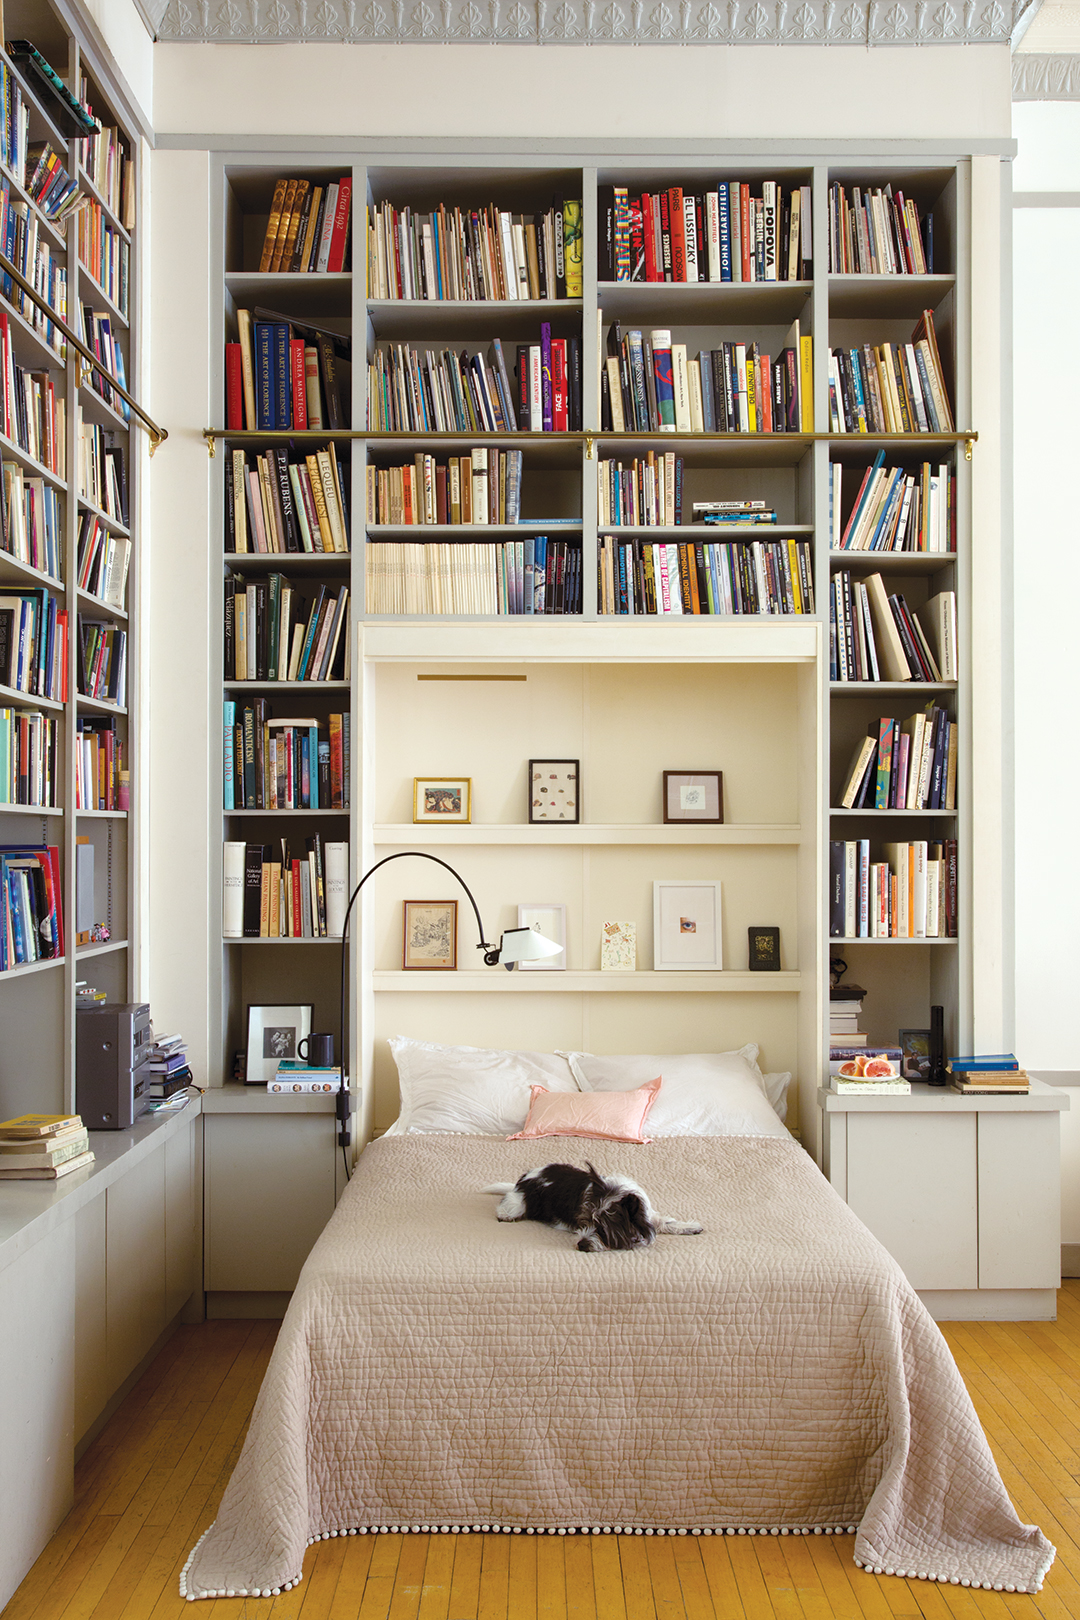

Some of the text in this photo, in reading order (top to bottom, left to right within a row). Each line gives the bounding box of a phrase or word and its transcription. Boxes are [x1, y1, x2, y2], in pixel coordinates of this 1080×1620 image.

[334, 186, 350, 230] Circa 1492
[672, 189, 680, 212] PARIS
[730, 191, 740, 240] John Heartfield
[322, 213, 333, 241] SIENA
[615, 193, 630, 282] BAUHAUS
[631, 200, 642, 248] TATLIN
[685, 197, 696, 264] EL LISSITZKY
[719, 184, 729, 271] JOHN HEARTFIELD
[766, 207, 775, 267] POPOVA
[662, 233, 671, 269] PRESENCES
[675, 246, 684, 282] MOSCOU
[262, 370, 269, 380] OF
[279, 369, 285, 380] OF
[262, 381, 270, 417] FLORENCE
[555, 393, 563, 412] FACE
[279, 475, 293, 516] RUBENS
[309, 467, 328, 519] PIRANESI
[321, 459, 335, 499] LEQUEU
[659, 547, 667, 569] HATRED
[679, 545, 691, 609] TERMINAL IDENTITY
[662, 577, 671, 610] CAPITALISM
[224, 595, 234, 638] Velázquez
[224, 725, 233, 782] PALLADIO
[244, 713, 254, 764] ROMANTICISM
